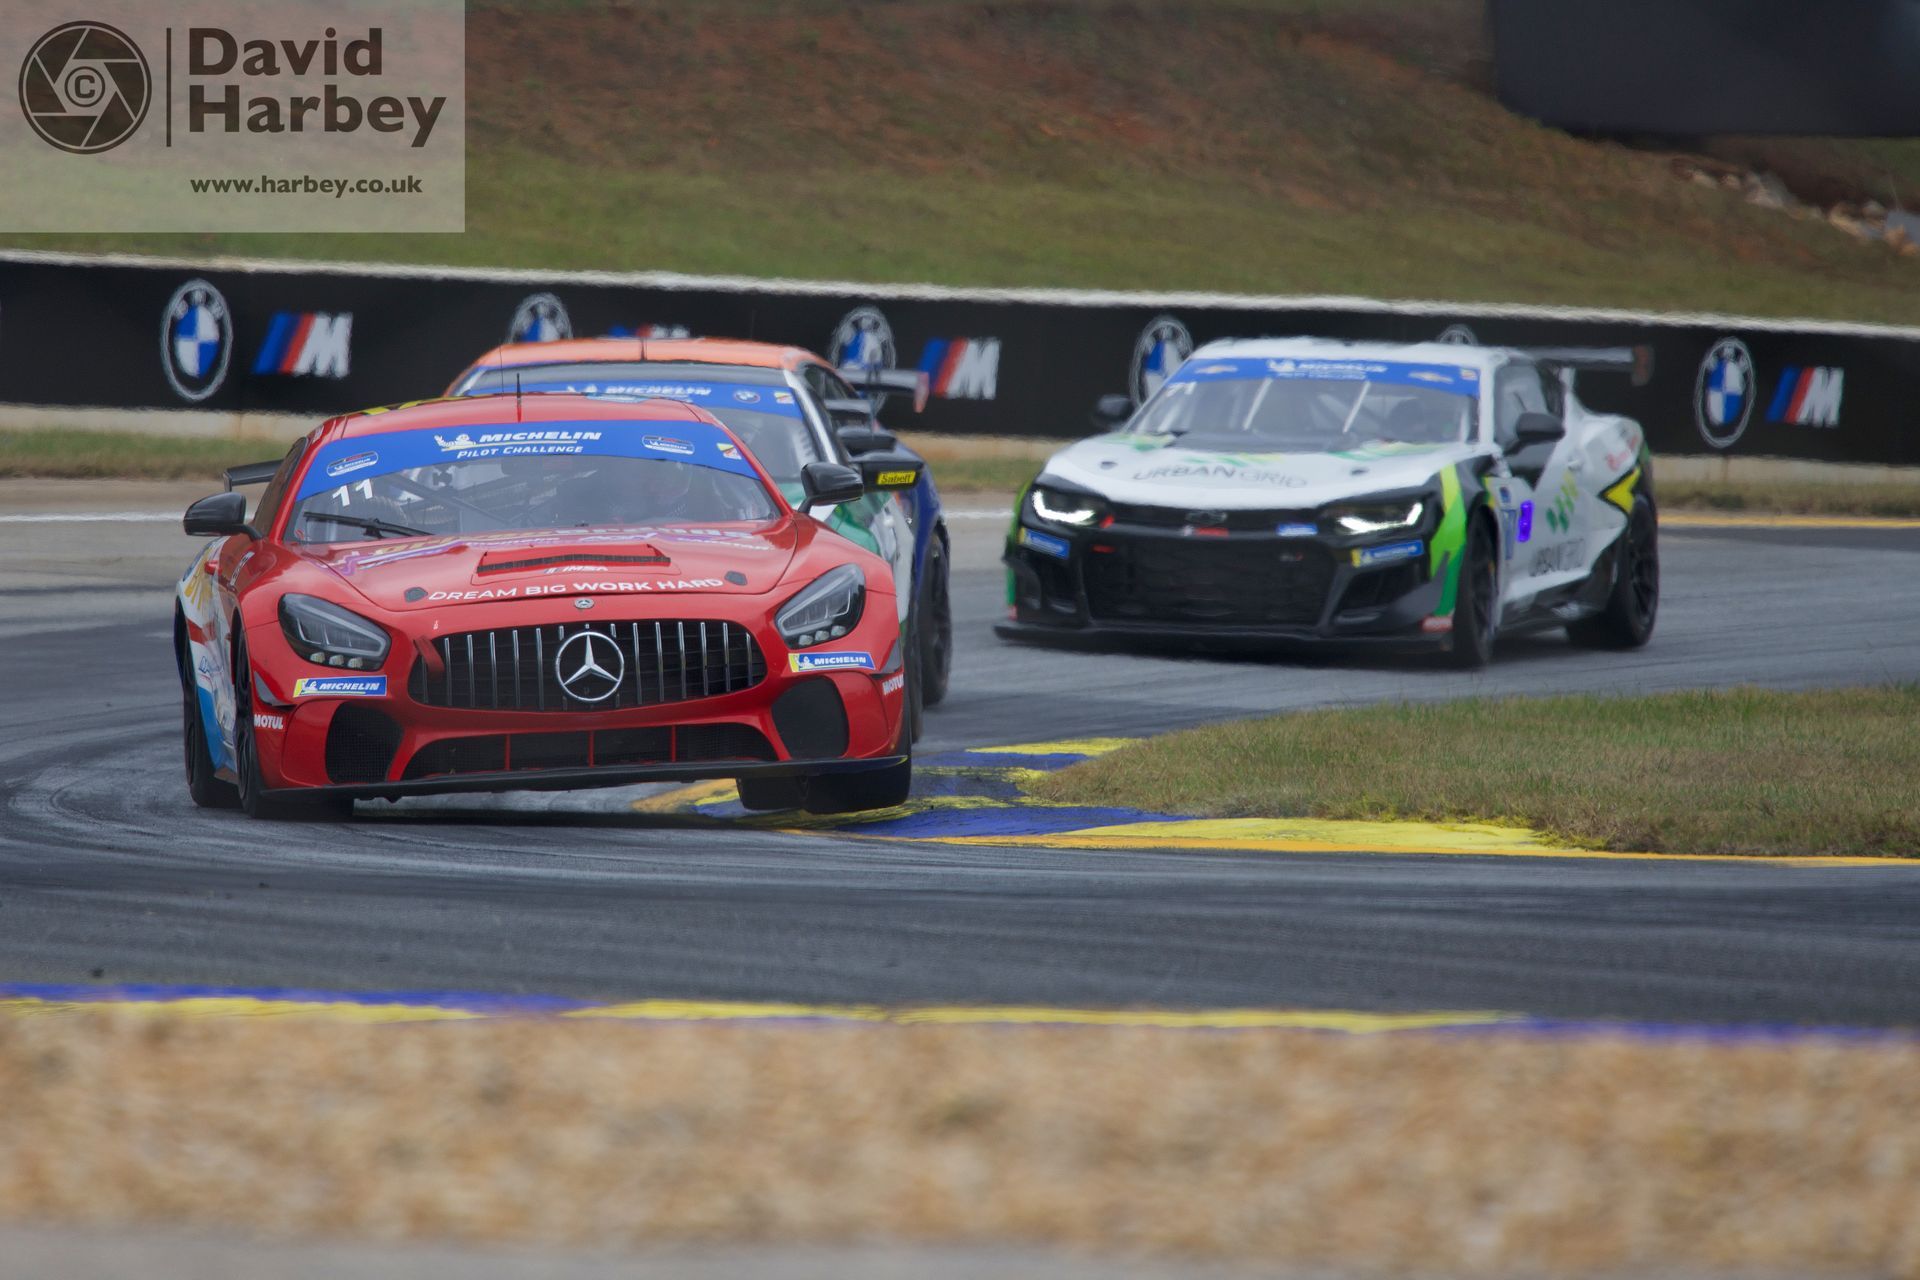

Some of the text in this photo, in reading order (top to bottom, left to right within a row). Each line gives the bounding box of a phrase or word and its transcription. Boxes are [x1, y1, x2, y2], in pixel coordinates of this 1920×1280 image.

[479, 431, 602, 443] MICHELIN
[456, 445, 584, 459] PILOT CHALLENGE
[332, 478, 374, 507] 11
[428, 579, 724, 601] DREAM BIG WORK HARD
[814, 655, 867, 666] MICHELIN
[318, 682, 381, 691] MICHELIN
[254, 713, 284, 730] MOTUL
